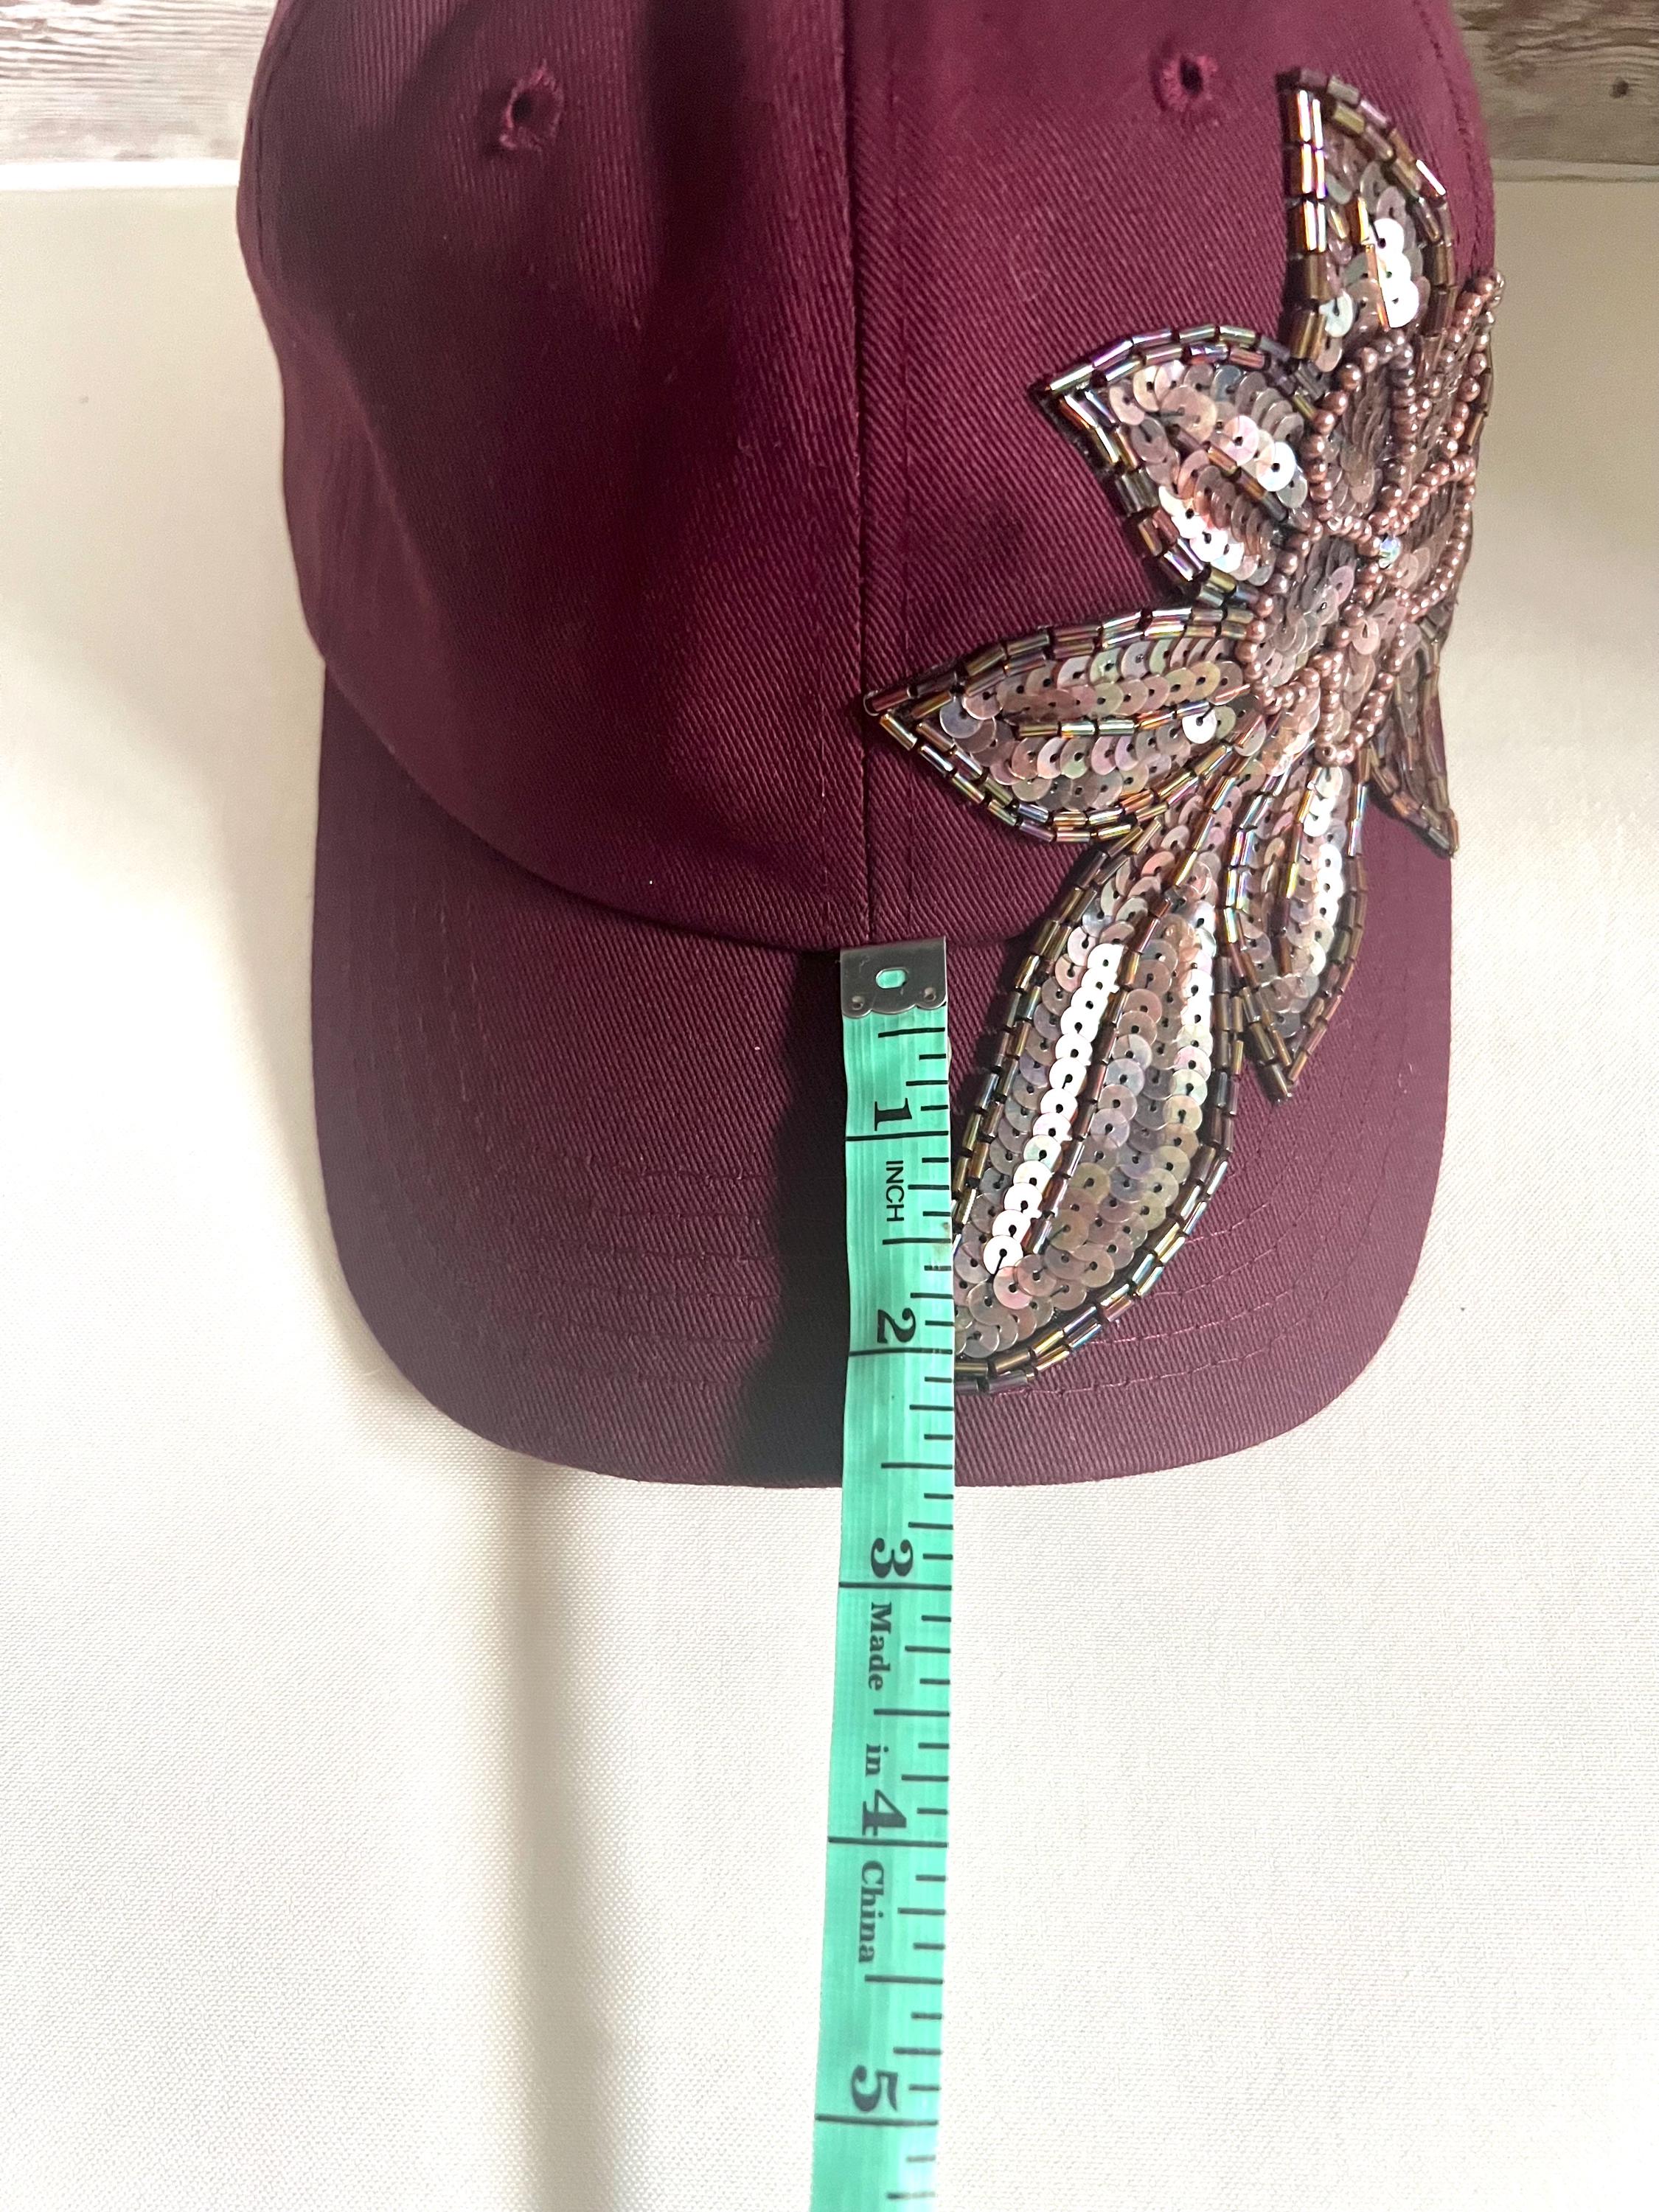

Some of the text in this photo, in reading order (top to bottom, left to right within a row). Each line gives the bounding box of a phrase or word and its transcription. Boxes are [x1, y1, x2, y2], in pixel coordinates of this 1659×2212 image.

[874, 1098, 912, 1131] 1
[886, 1160, 905, 1222] INCH
[877, 1307, 916, 1343] 2
[871, 1537, 914, 1578] 3
[858, 1601, 892, 1963] Made in China
[862, 1789, 907, 1836] 4
[851, 2065, 898, 2112] 5
